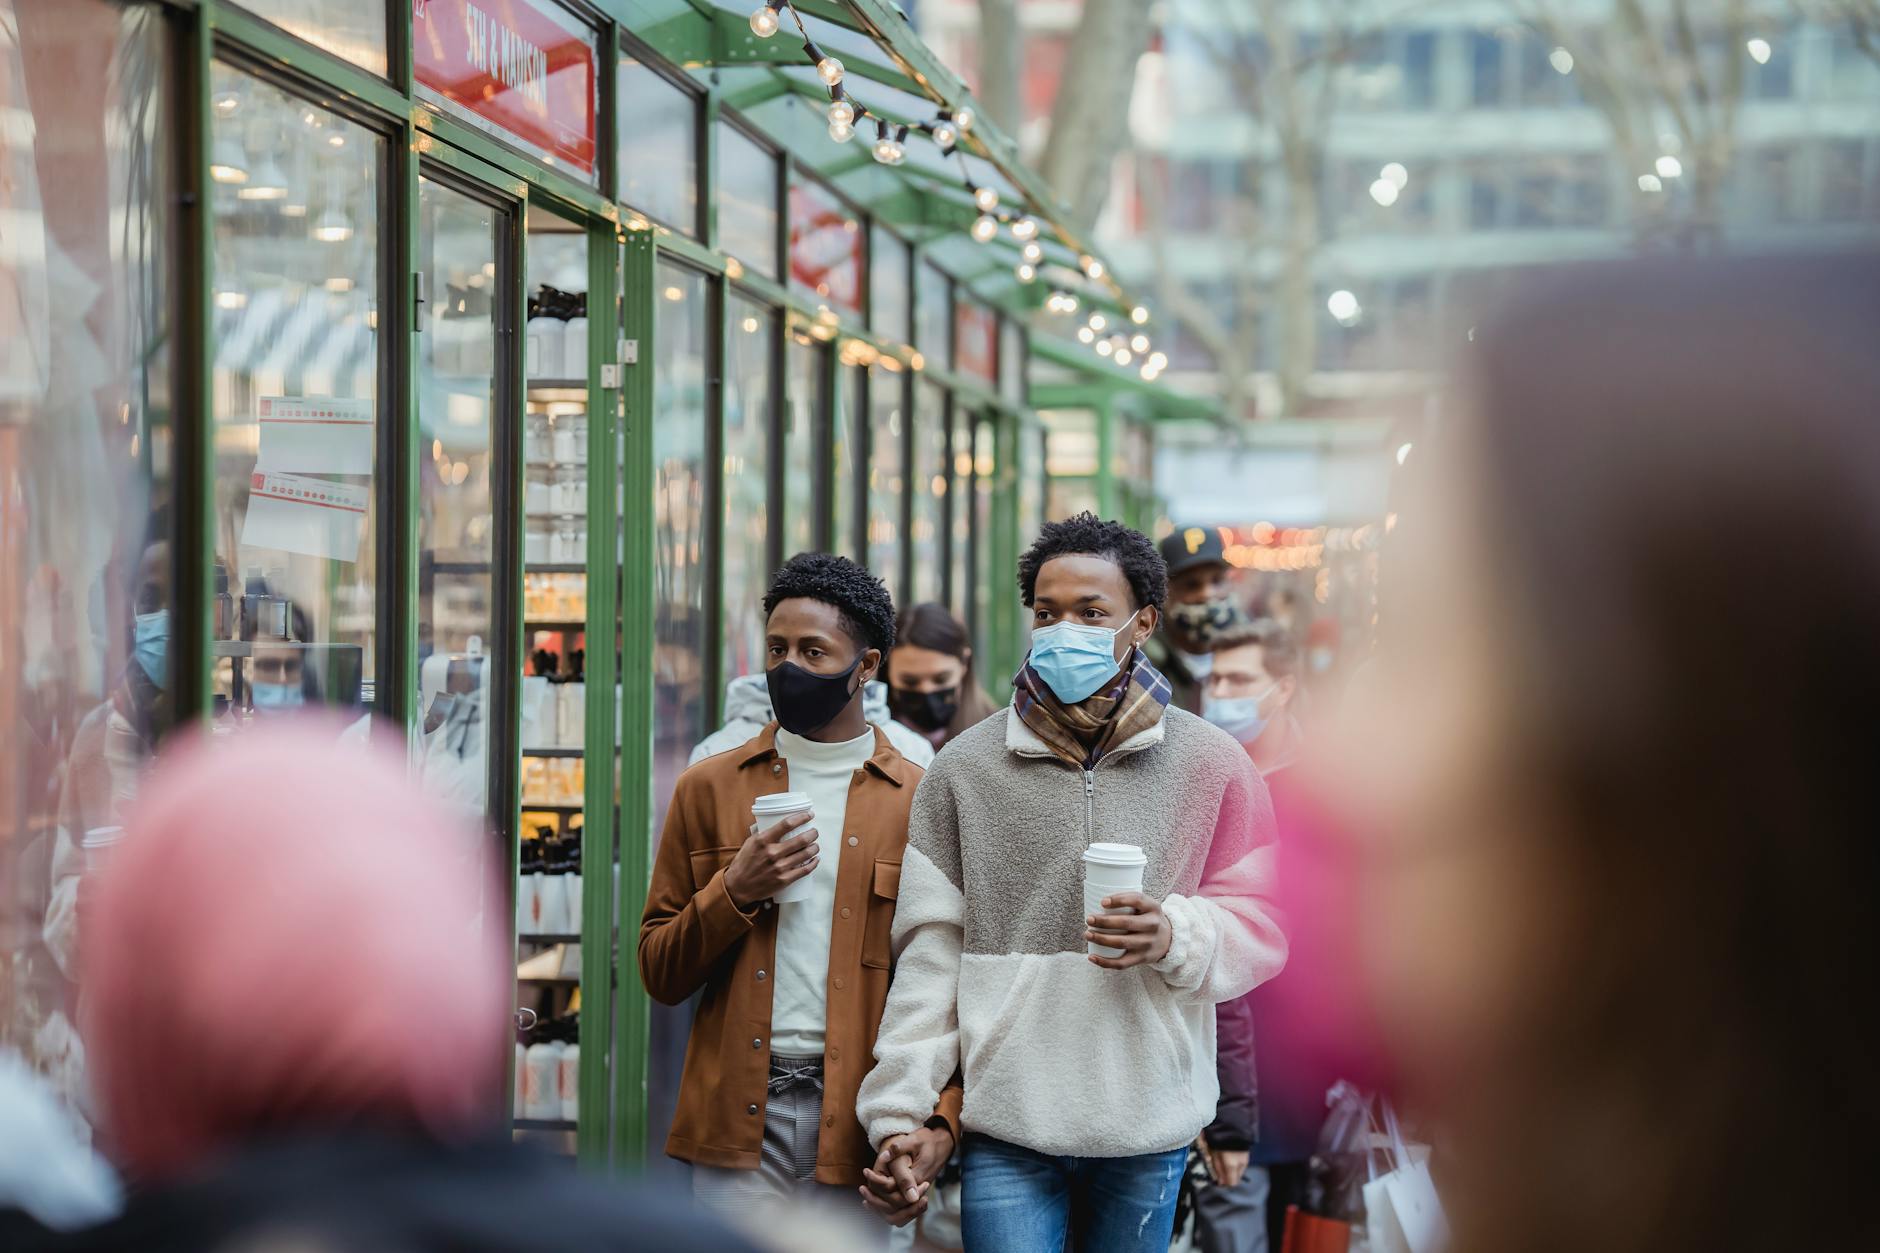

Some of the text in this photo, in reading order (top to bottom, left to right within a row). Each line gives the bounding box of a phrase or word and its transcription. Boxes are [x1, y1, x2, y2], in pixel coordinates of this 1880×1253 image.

[466, 2, 547, 106] 5TH & MADISON
[1184, 527, 1206, 555] P
